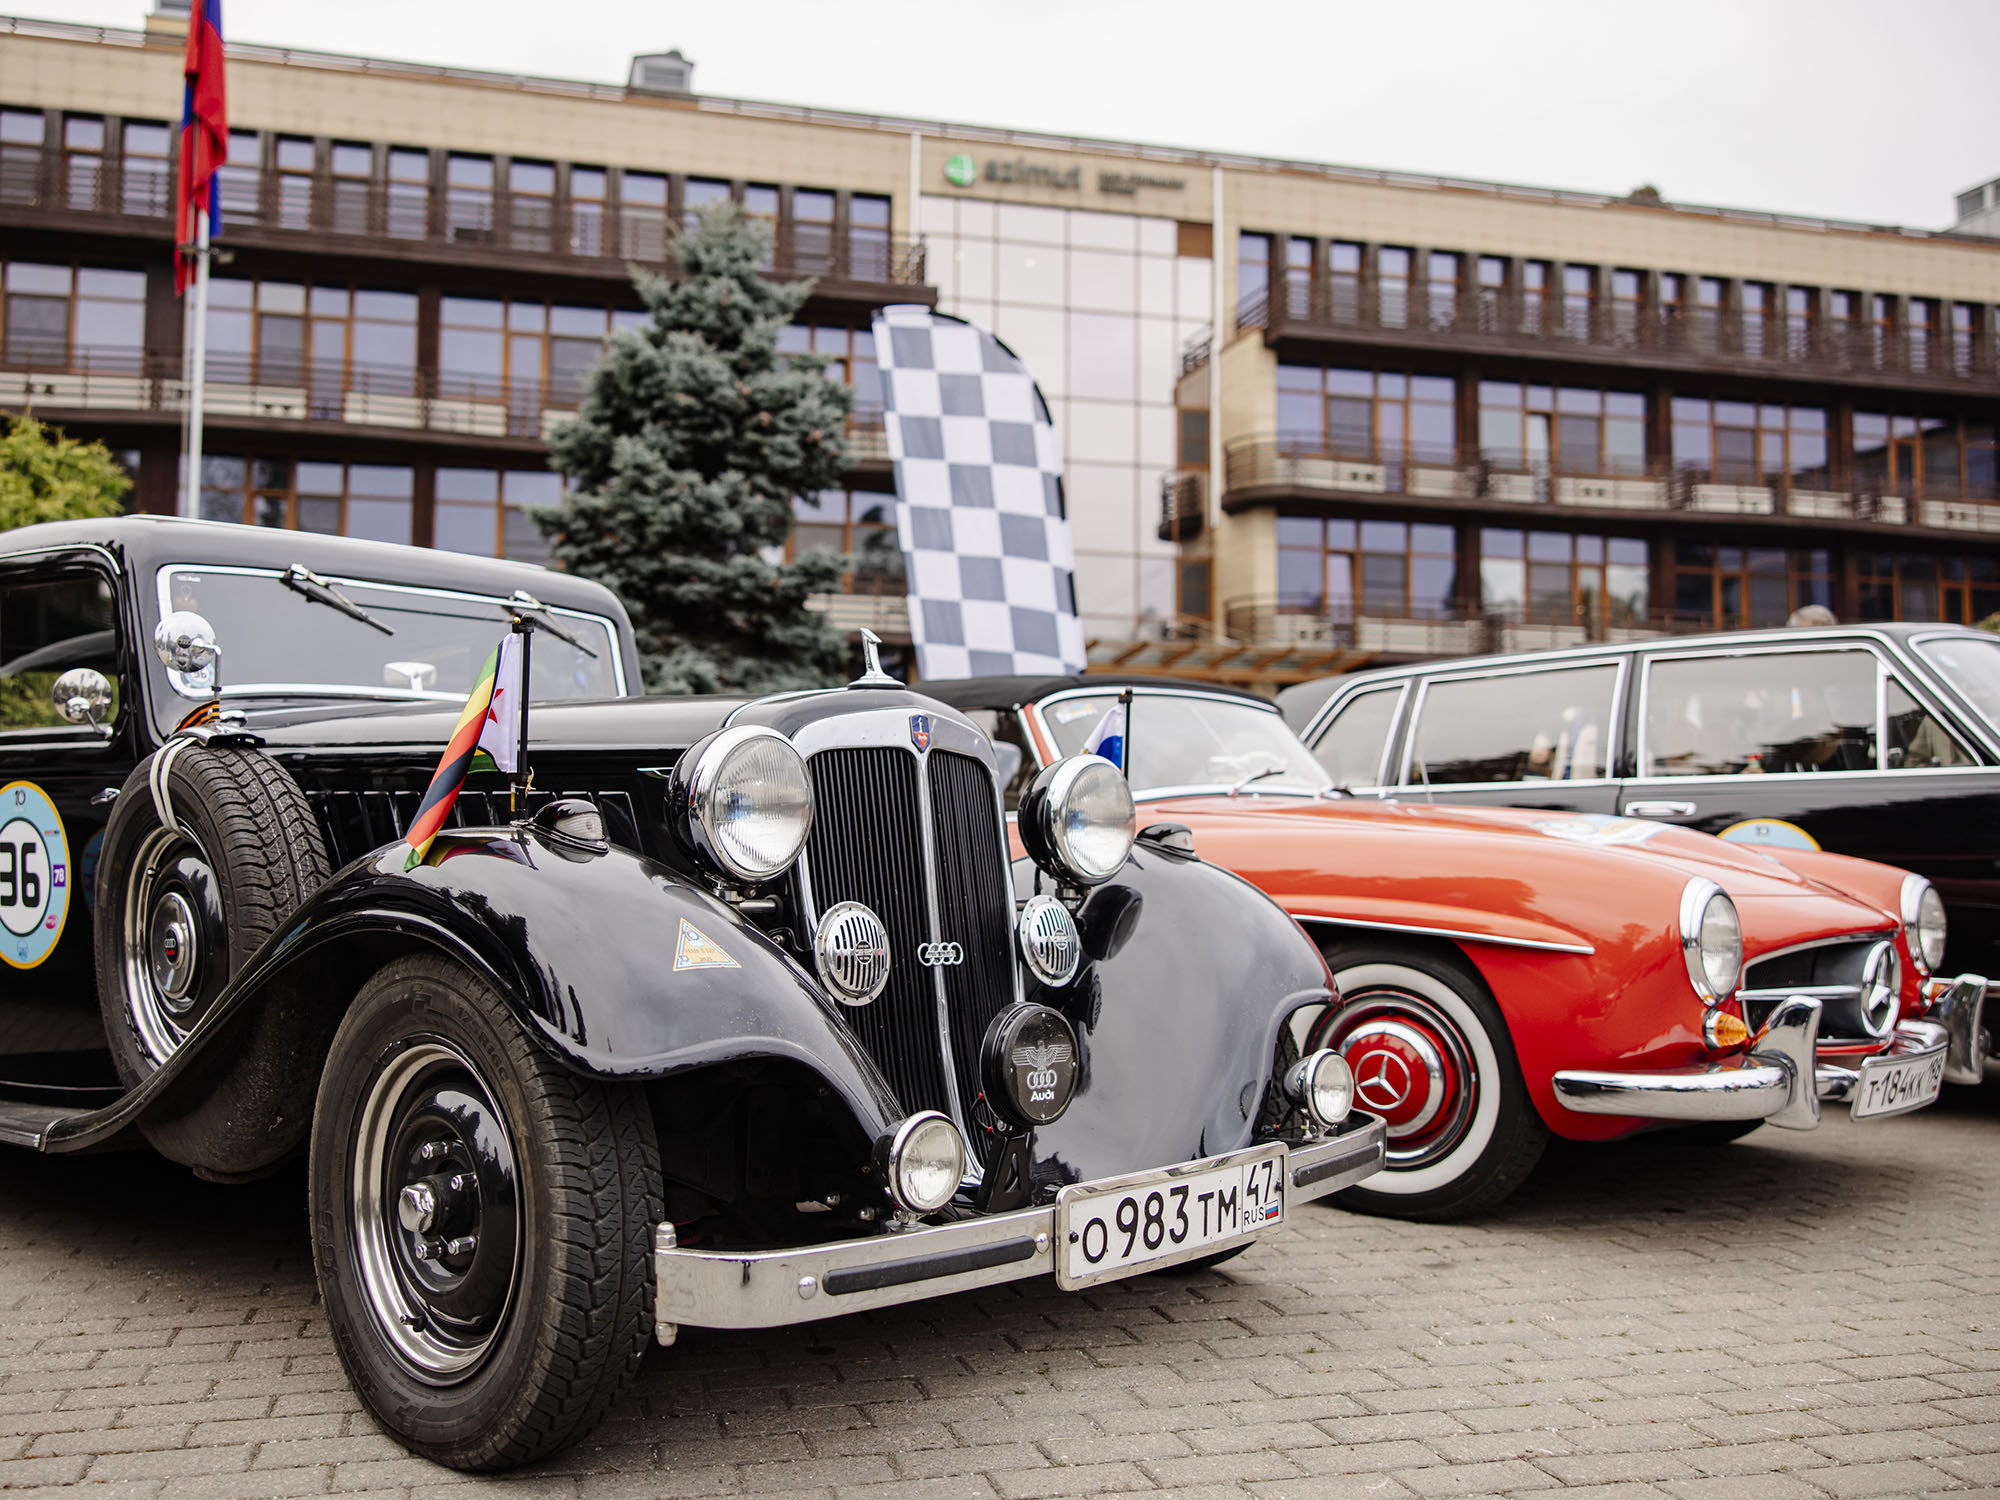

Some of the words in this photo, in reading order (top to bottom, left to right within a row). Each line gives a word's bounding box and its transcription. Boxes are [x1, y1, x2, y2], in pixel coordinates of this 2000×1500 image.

[0, 842, 40, 907] 36
[1030, 1090, 1055, 1102] Audi
[1246, 1160, 1274, 1205] 47
[1243, 1206, 1265, 1226] RUS
